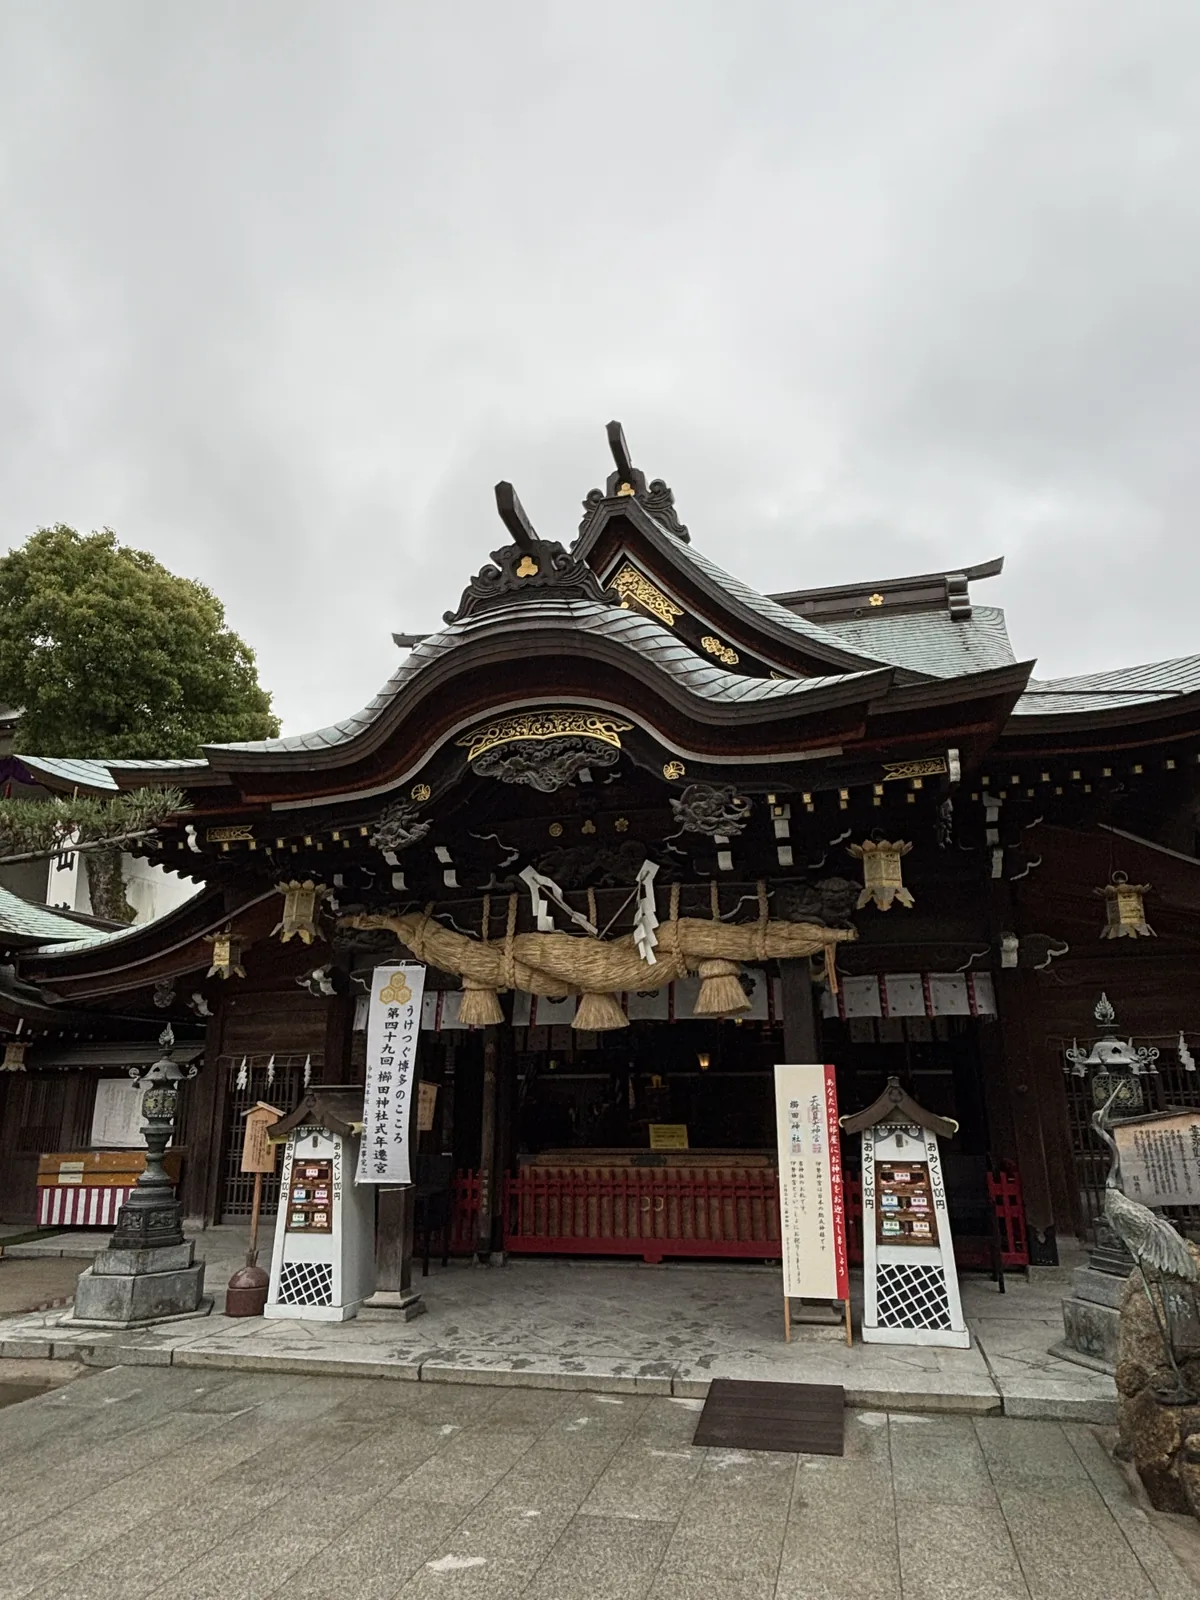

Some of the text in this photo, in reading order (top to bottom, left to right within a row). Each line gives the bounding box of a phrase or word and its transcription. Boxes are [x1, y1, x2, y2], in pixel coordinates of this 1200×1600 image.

[394, 1005, 414, 1144] うけつぐ博多のこころ
[790, 1100, 801, 1142] 櫛田神社
[827, 1079, 845, 1276] あなたのお部屋にお神様をお迎えしましょう
